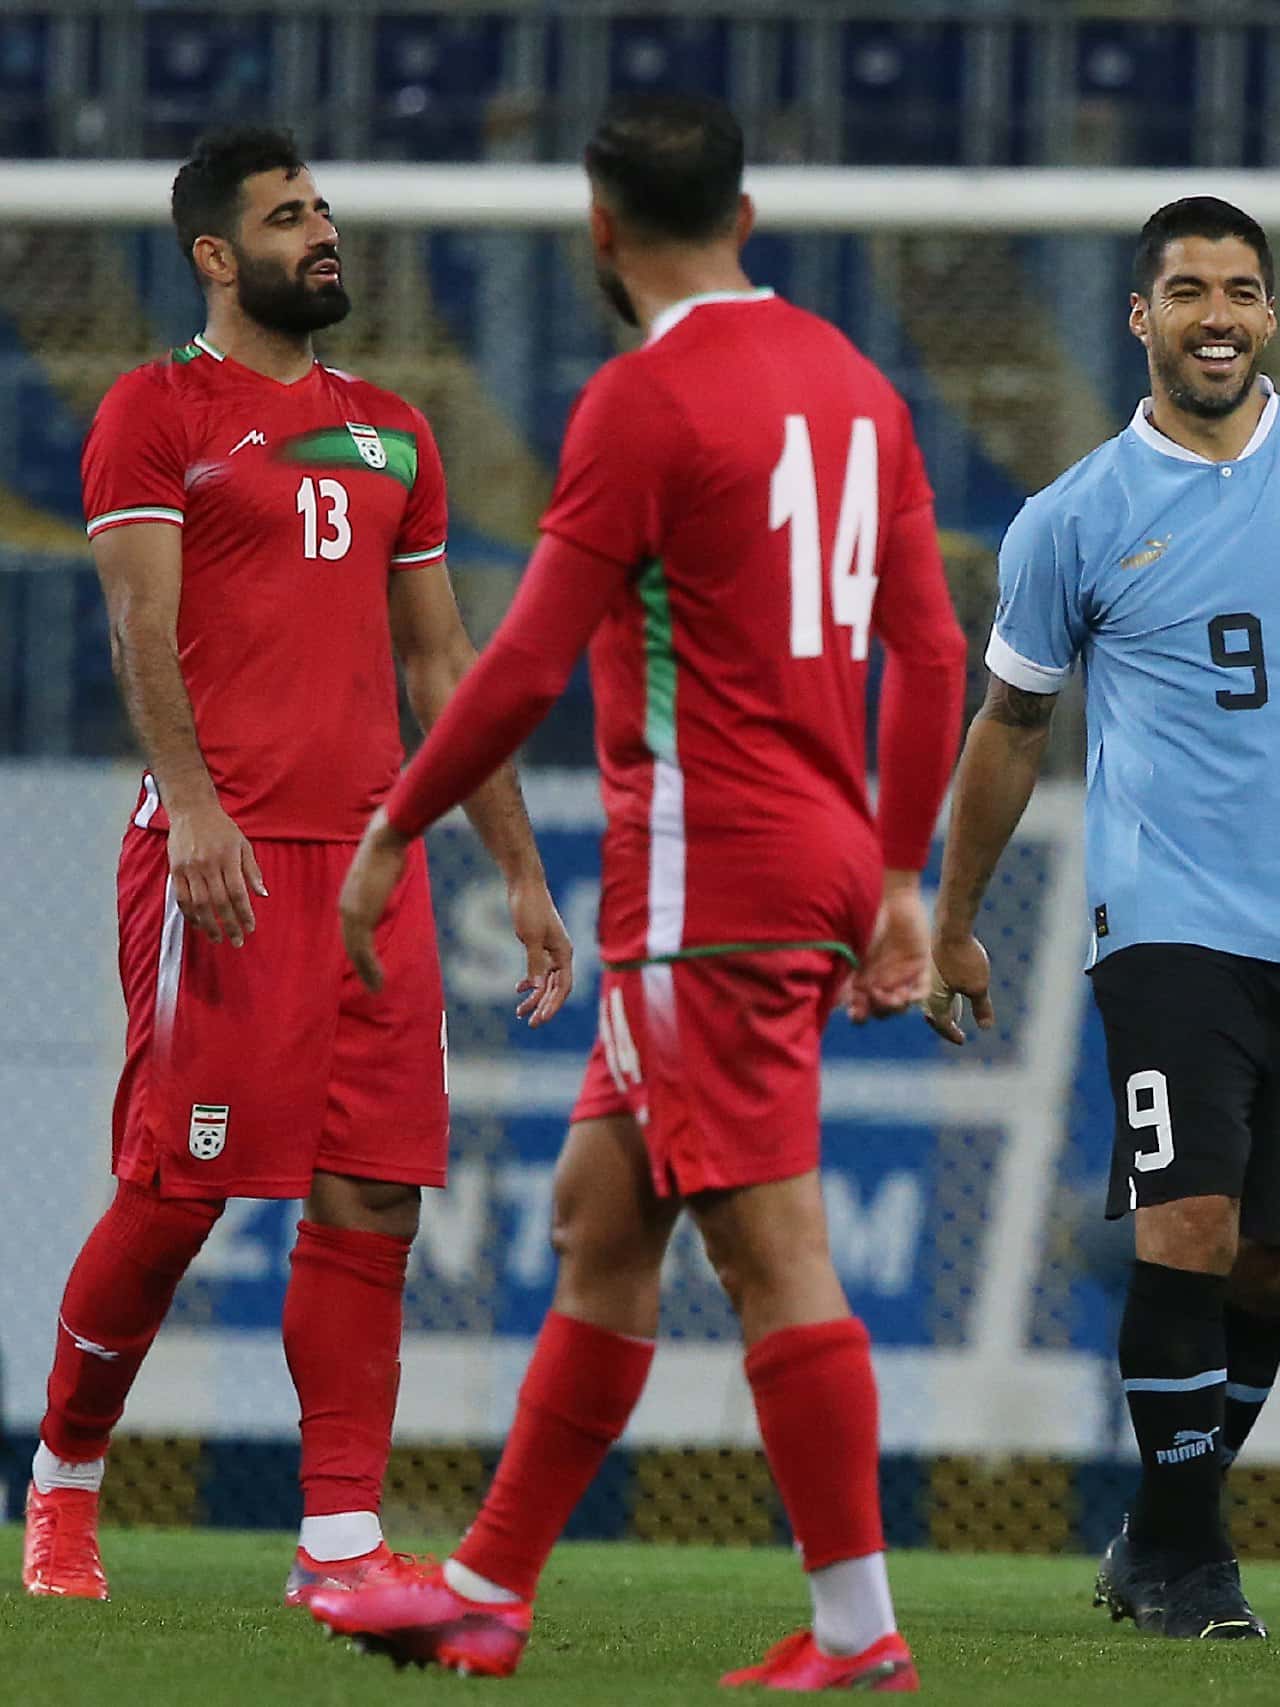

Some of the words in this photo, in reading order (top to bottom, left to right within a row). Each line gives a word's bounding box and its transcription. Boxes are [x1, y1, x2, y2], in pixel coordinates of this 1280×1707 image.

[296, 477, 351, 561] 13
[769, 414, 880, 662] 14
[1207, 612, 1269, 711] 9
[1126, 1069, 1175, 1173] 9
[1156, 1439, 1207, 1465] PUMA
